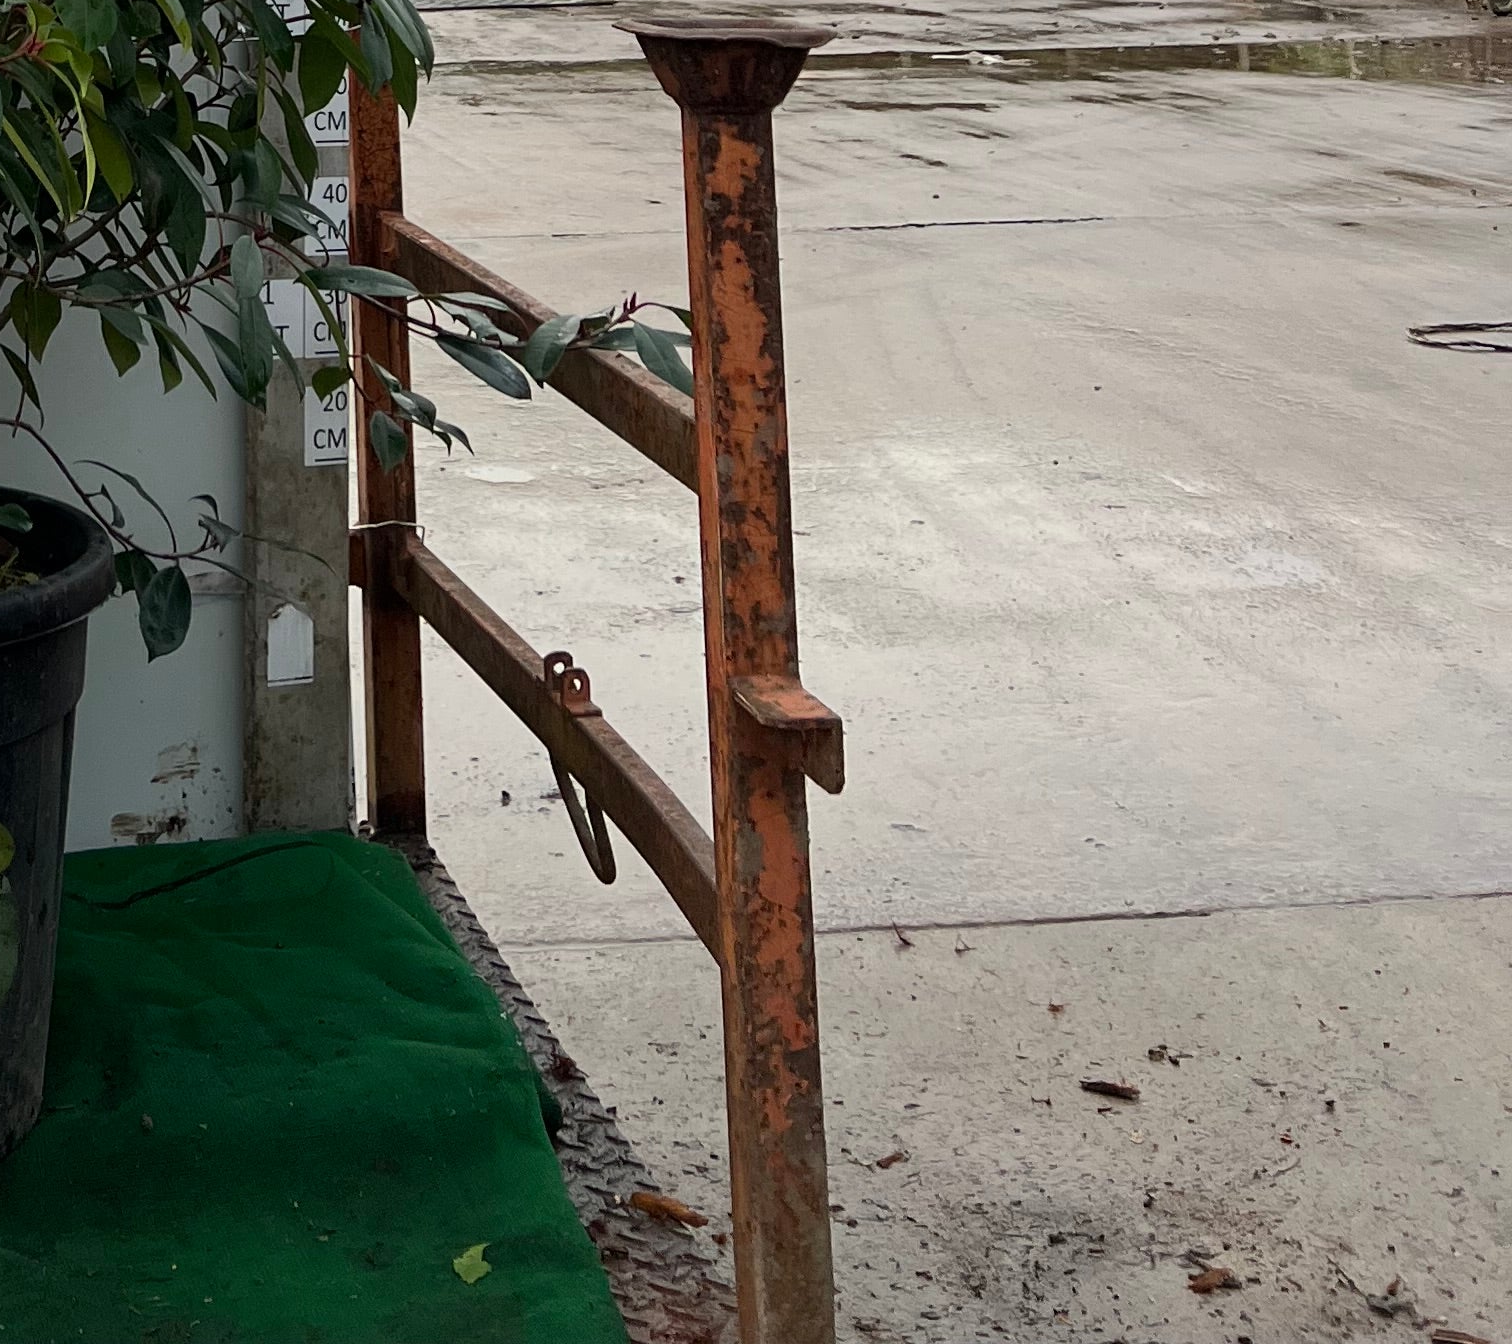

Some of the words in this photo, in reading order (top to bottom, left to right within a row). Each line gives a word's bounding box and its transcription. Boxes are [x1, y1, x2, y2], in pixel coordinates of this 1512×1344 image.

[314, 111, 347, 131] CM
[322, 183, 348, 204] 40
[323, 391, 348, 412] 20
[313, 427, 347, 449] CM
